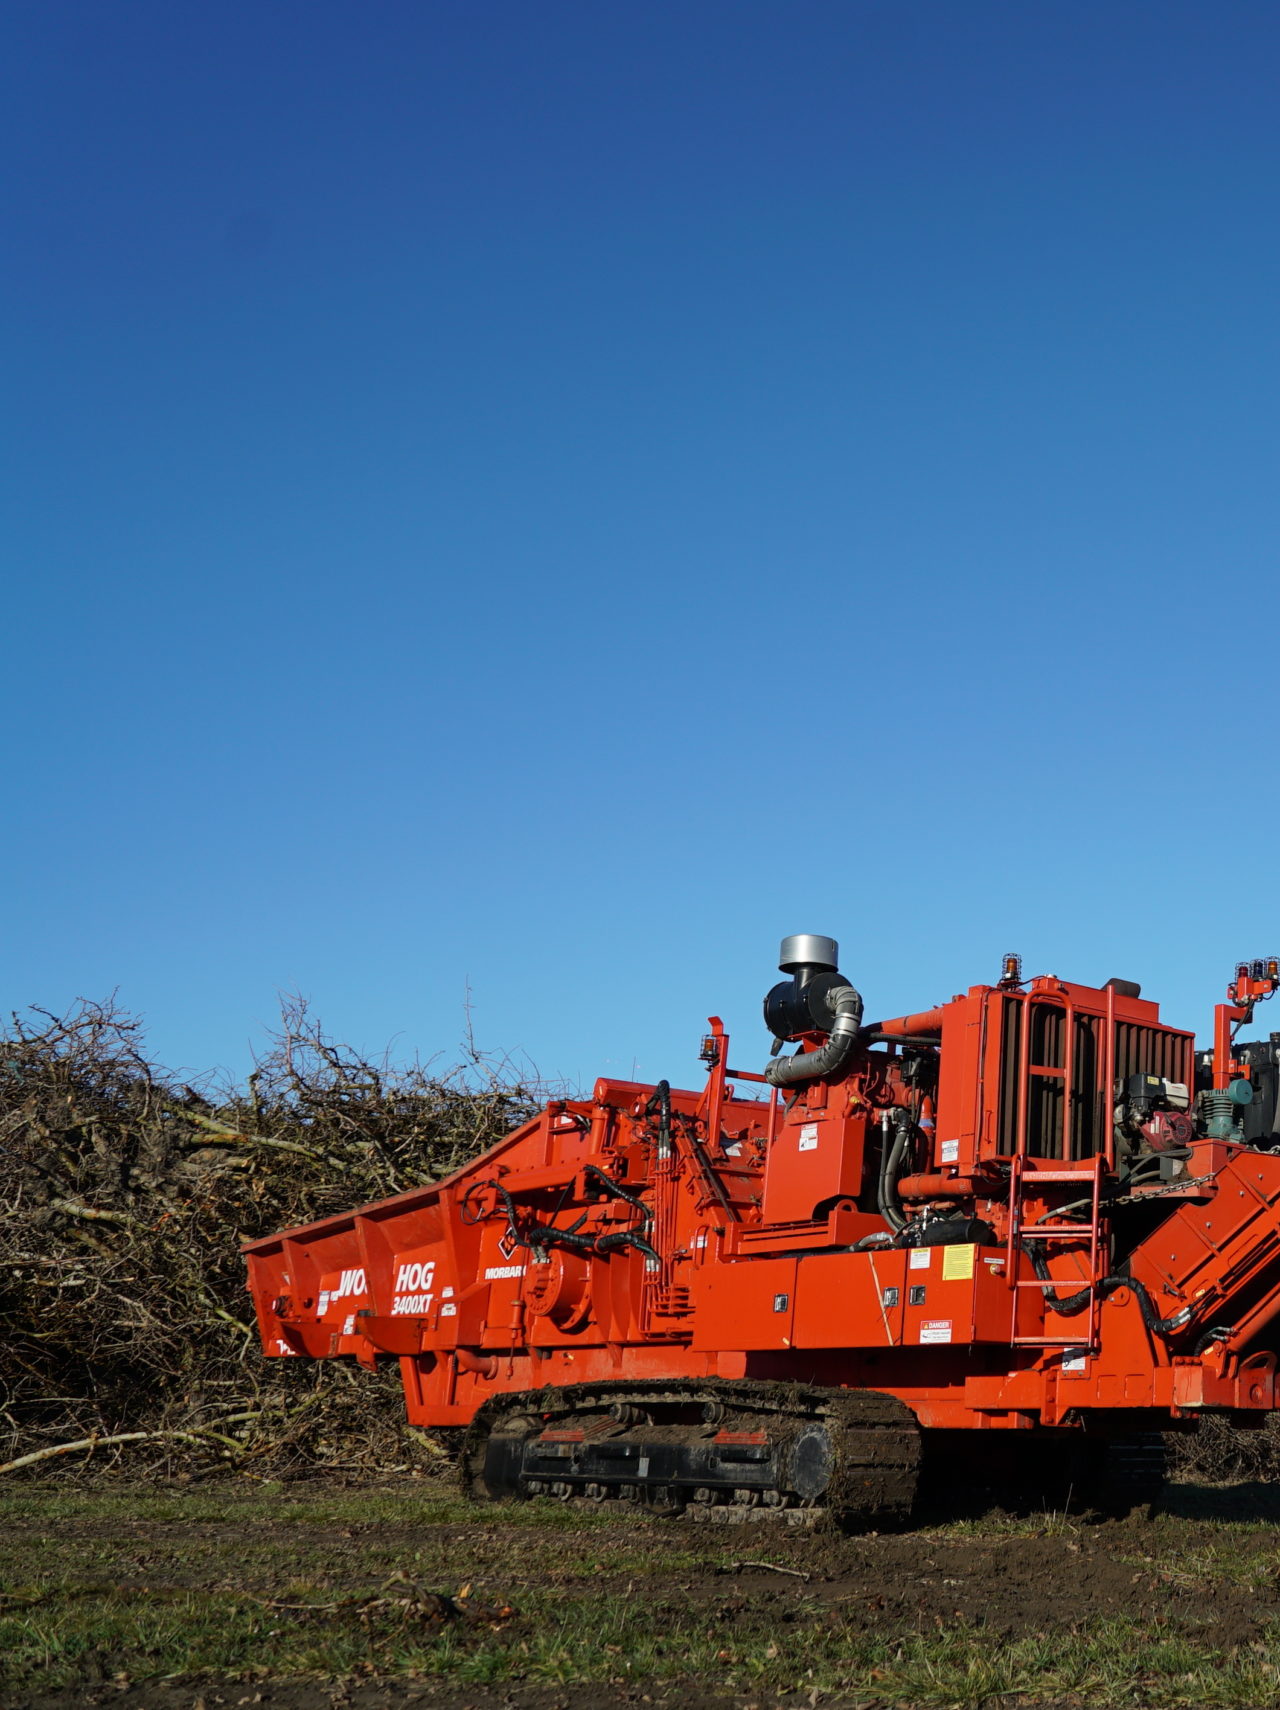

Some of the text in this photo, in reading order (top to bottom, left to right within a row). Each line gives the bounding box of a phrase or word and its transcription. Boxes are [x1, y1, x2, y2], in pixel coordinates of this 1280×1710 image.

[395, 1261, 435, 1292] HOG
[391, 1294, 434, 1315] 3400XT
[929, 1321, 950, 1329] DANGER
